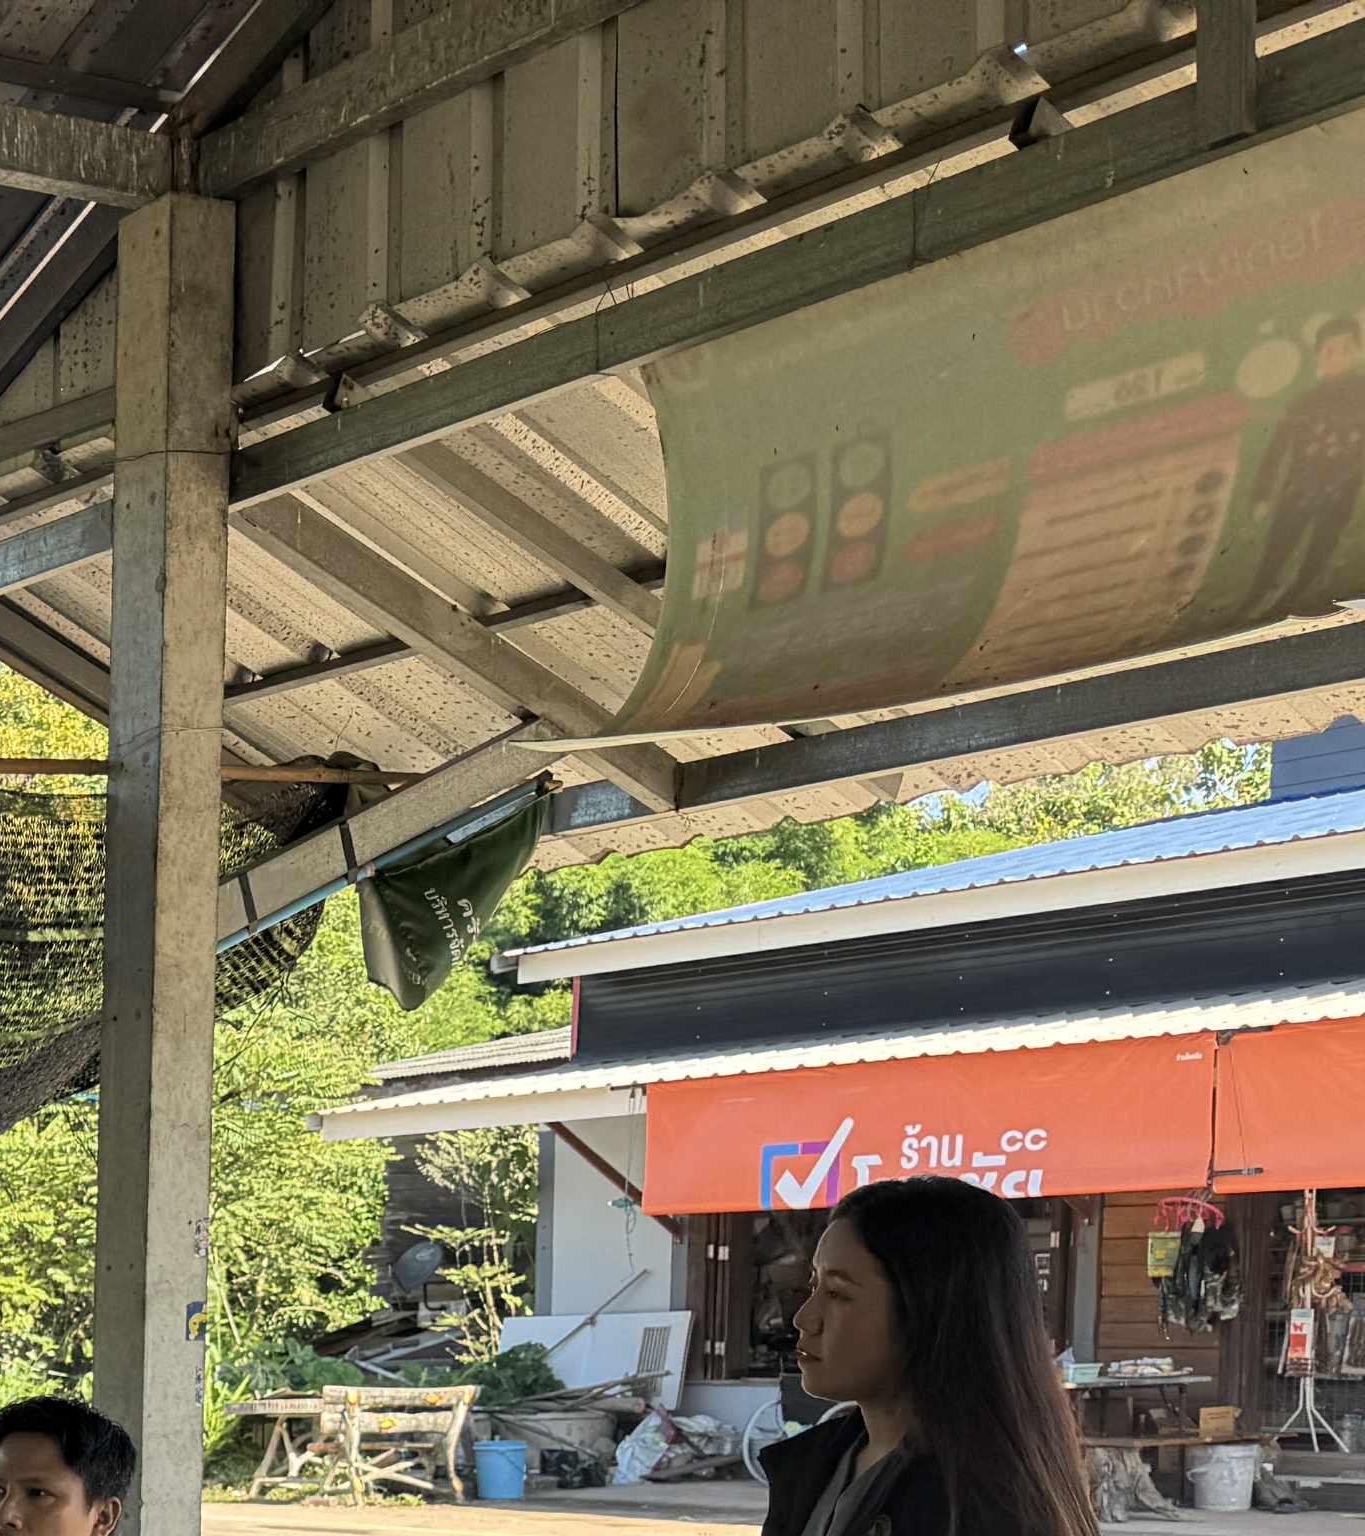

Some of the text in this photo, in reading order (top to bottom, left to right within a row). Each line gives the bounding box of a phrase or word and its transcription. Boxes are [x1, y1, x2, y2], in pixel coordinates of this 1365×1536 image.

[424, 887, 465, 967] บริหารจัด
[900, 1123, 964, 1169] ร้าน
